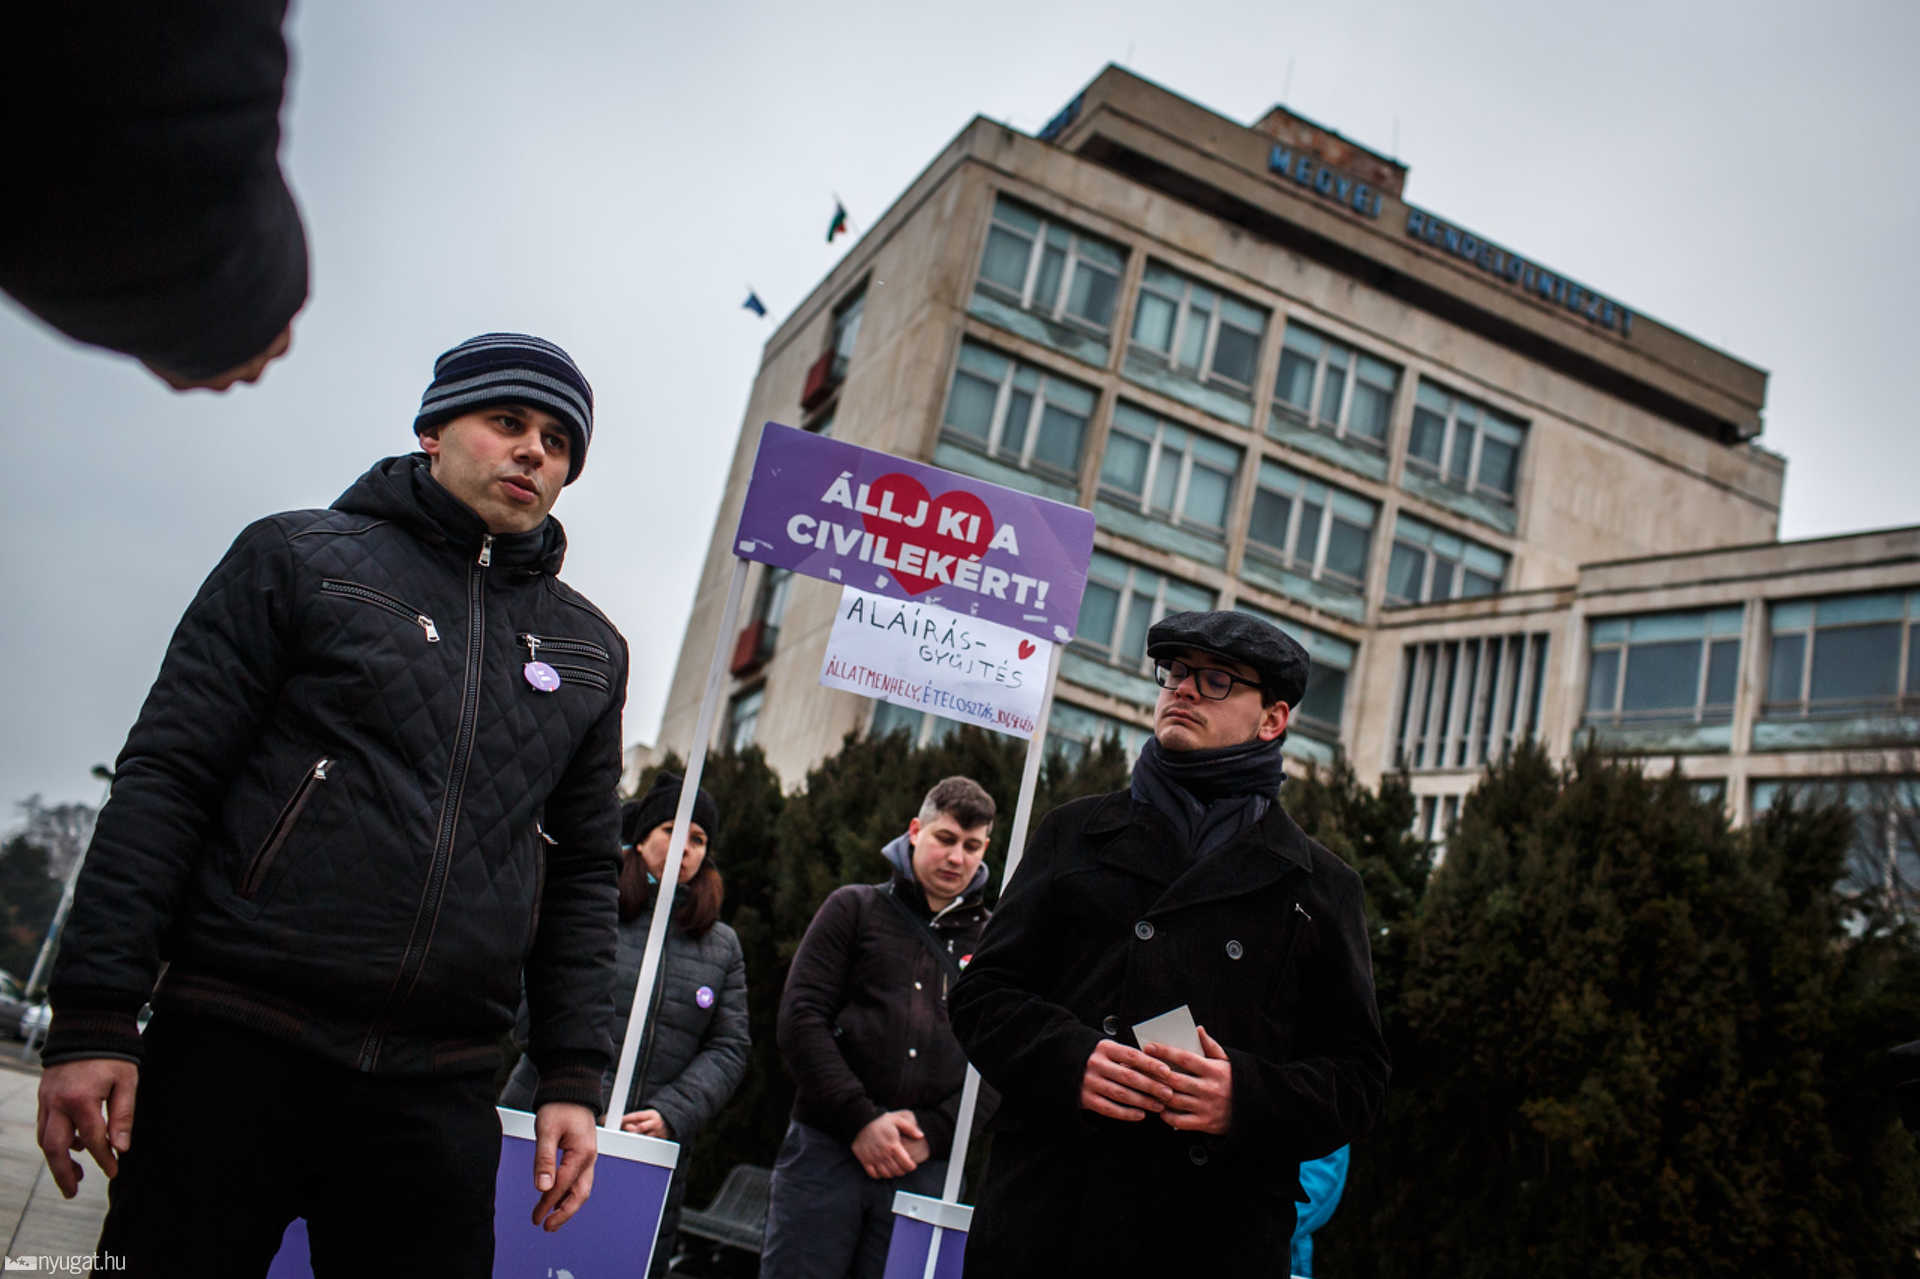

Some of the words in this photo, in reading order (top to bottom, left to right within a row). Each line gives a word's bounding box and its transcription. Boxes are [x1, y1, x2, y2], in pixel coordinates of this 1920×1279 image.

[1268, 145, 1382, 218] MEGYEI
[821, 471, 929, 527] ÁLLJ
[937, 507, 981, 544] KI
[989, 524, 1020, 556] A
[786, 514, 1050, 610] CIVILEKÉRT!
